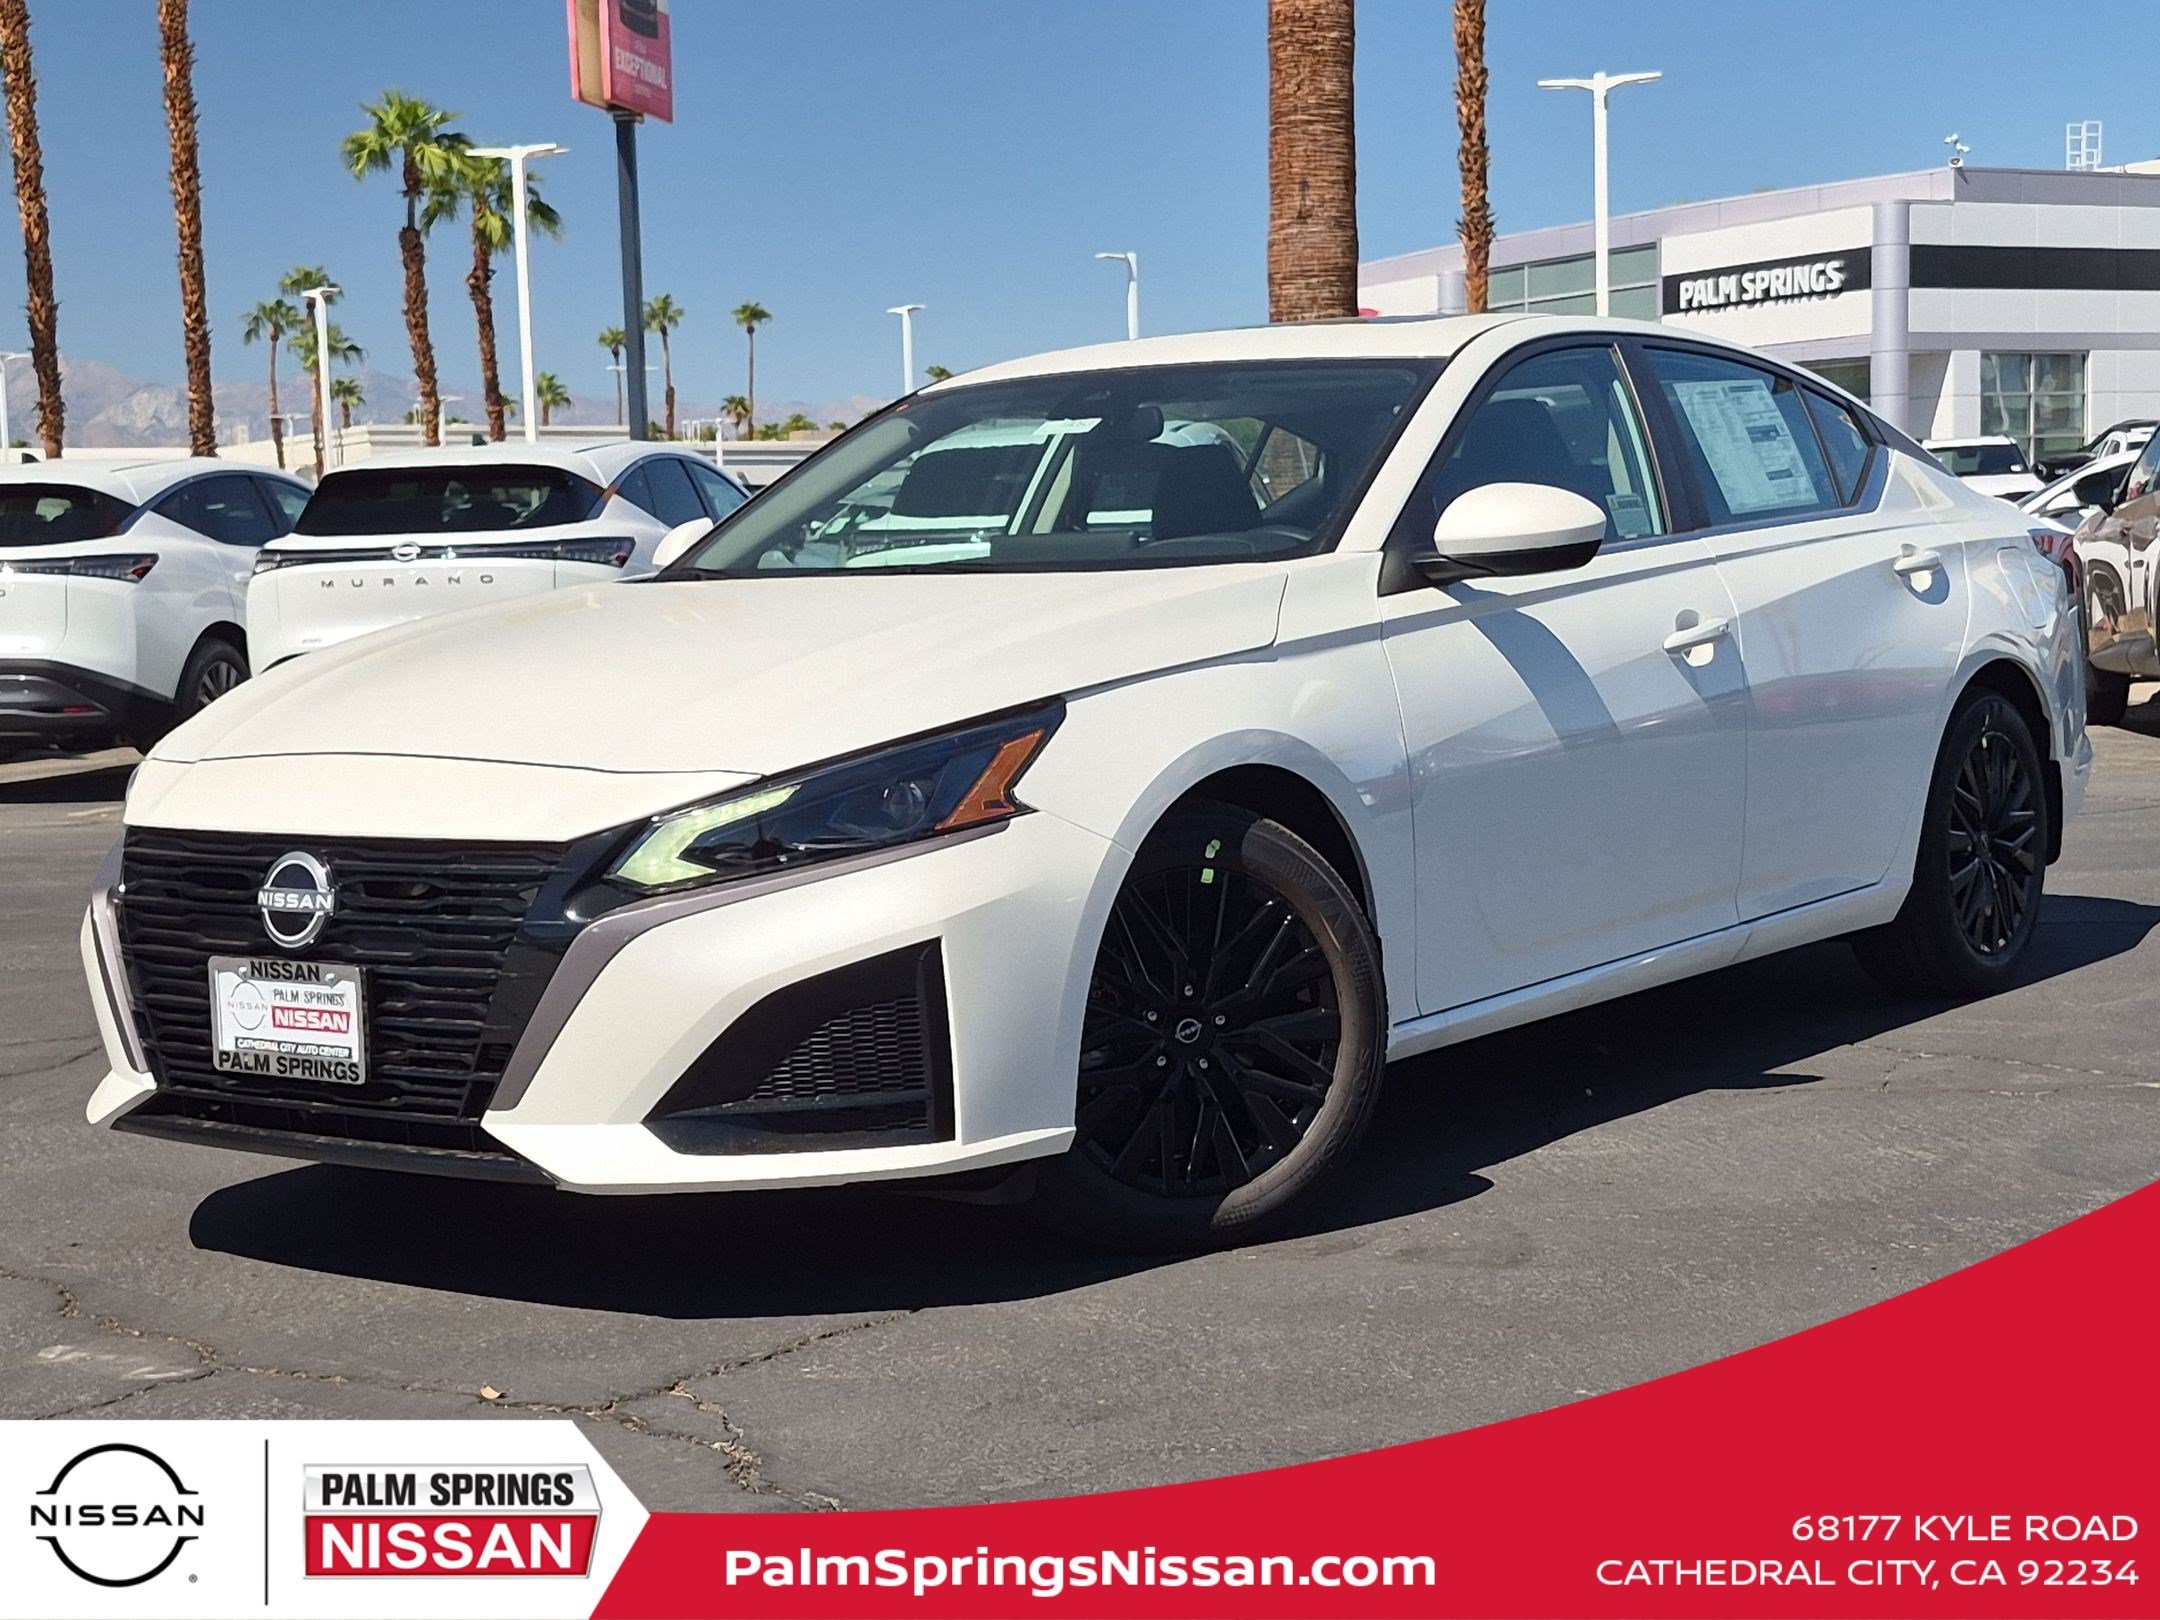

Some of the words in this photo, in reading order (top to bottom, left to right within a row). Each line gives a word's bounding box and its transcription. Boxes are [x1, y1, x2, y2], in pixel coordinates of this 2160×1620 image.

[1679, 275, 1738, 310] PALM
[1741, 260, 1845, 301] SPRINGS
[321, 574, 494, 589] MURANO
[257, 889, 333, 911] NISSAN
[249, 960, 321, 983] NISSAN
[227, 1000, 269, 1011] NISSAN
[273, 989, 300, 1004] PALM
[303, 990, 345, 1007] SPRINGS
[274, 1008, 349, 1032] NISSAN
[237, 1038, 279, 1052] CATHEDRAL
[280, 1042, 297, 1054] CITY
[296, 1044, 319, 1056] AUTO
[319, 1046, 351, 1058] CENTER
[218, 1050, 271, 1073] PALM
[276, 1055, 360, 1083] SPRINGS
